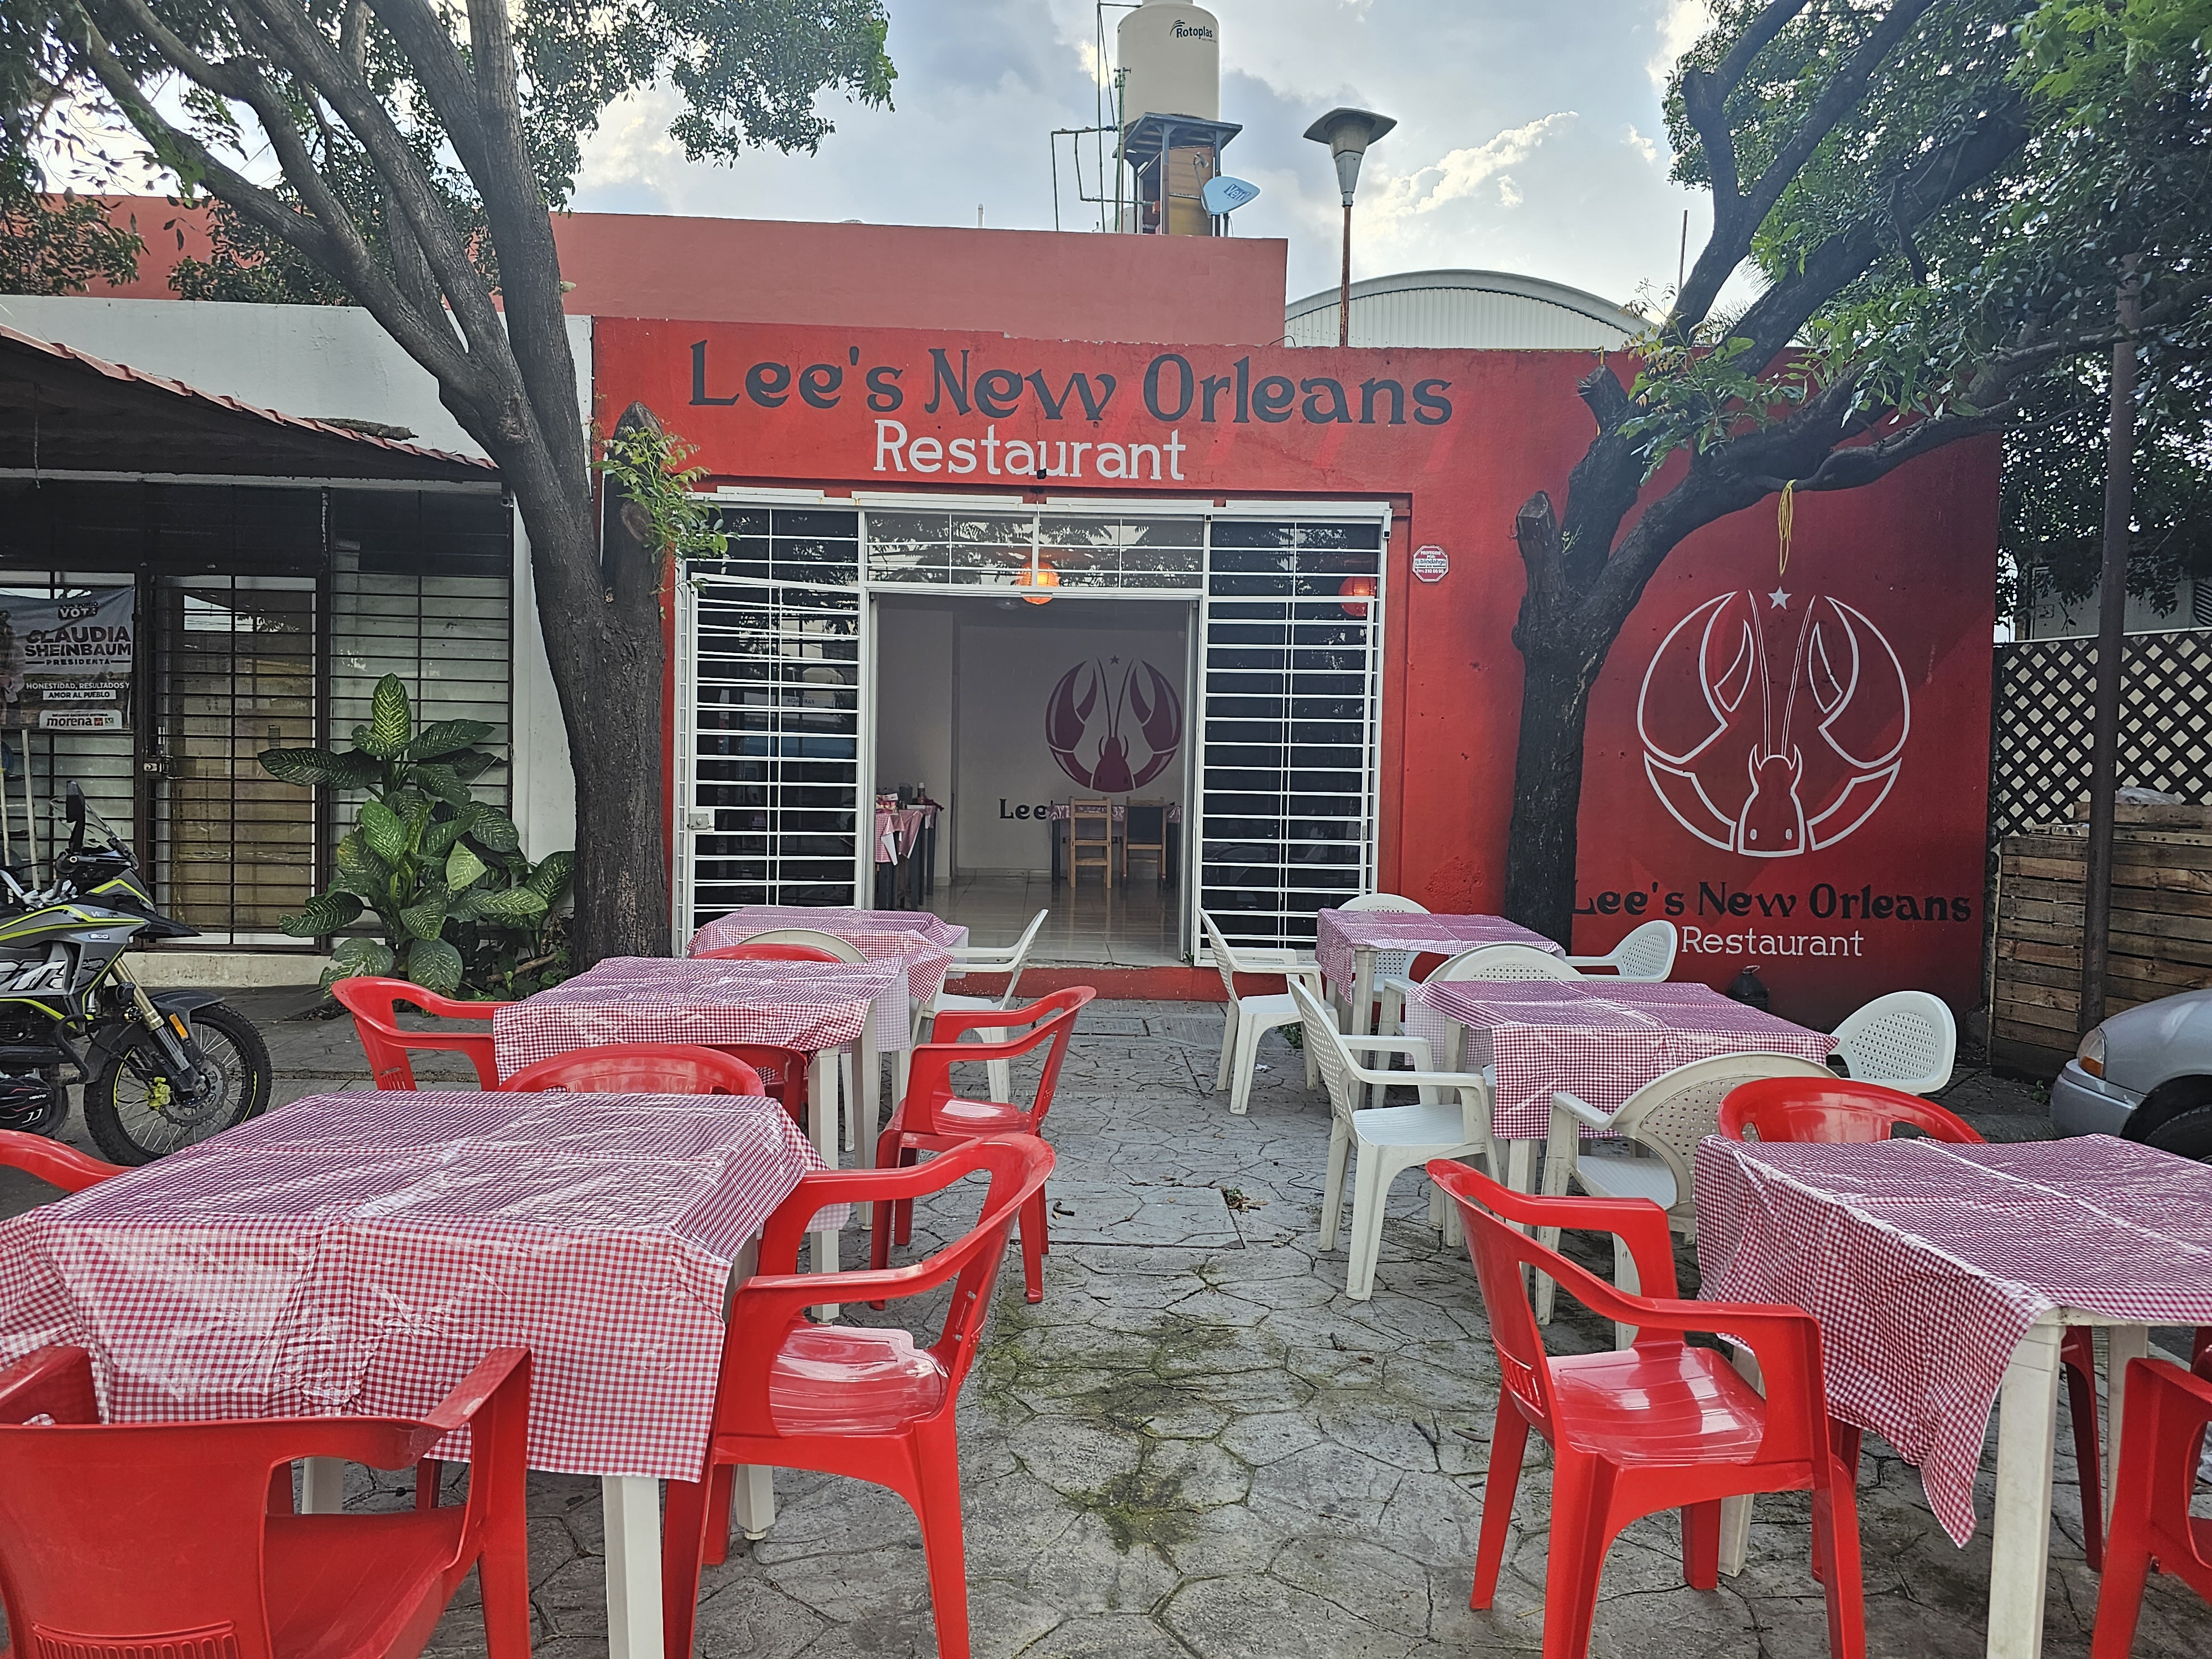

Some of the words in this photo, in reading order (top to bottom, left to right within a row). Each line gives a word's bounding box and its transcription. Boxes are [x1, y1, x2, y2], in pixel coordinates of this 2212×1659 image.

[1176, 26, 1213, 39] Rotoplas
[688, 340, 904, 413] Lee's
[924, 348, 1117, 421] New
[1143, 353, 1453, 425] Orleans
[873, 419, 1186, 481] Restaurant
[26, 626, 131, 644] CLAUDIA
[25, 644, 131, 657] SHEINBAUM
[46, 718, 92, 726] morena
[1698, 881, 1797, 917] New
[1809, 883, 1971, 922] Orleans
[1681, 926, 1864, 957] Restaurant
